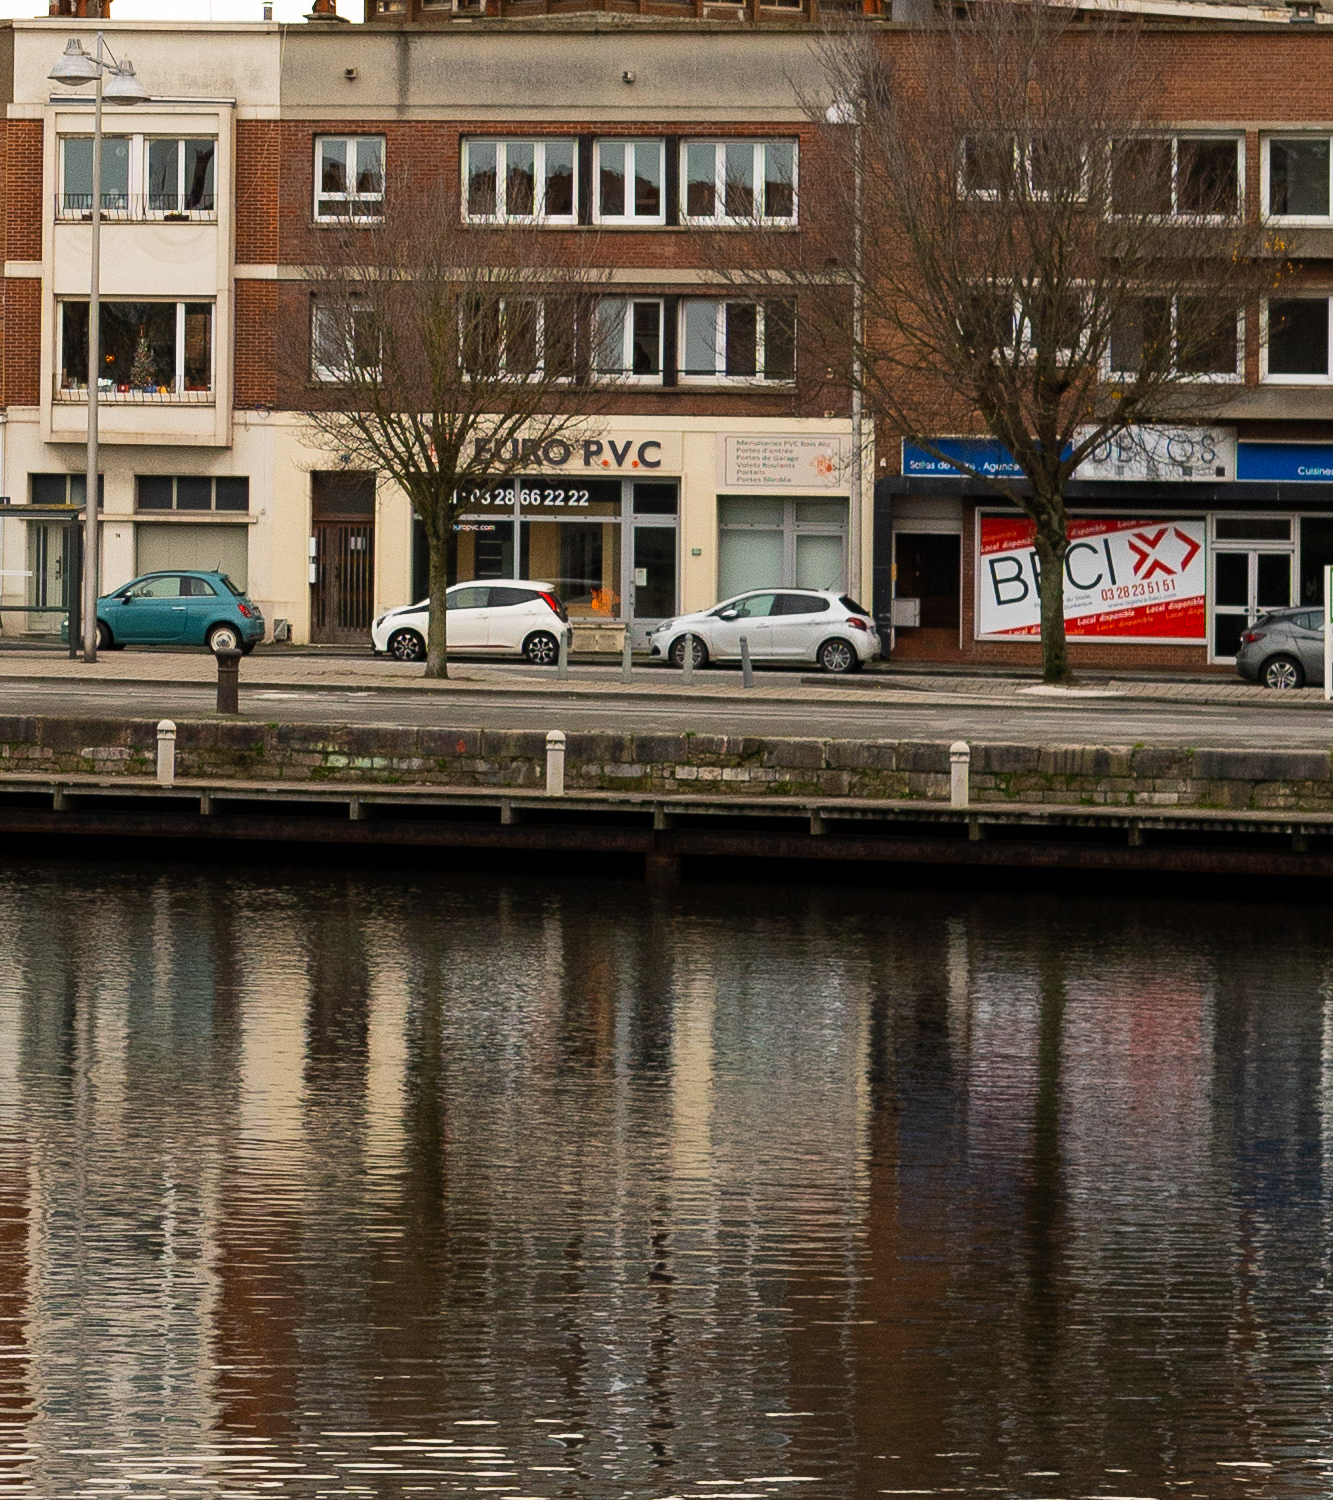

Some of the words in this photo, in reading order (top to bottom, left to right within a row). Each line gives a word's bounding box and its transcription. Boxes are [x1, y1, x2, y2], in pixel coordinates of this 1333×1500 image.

[474, 438, 572, 467] EURO
[773, 455, 799, 464] Garage
[937, 460, 951, 470] de
[494, 489, 515, 505] 28
[520, 489, 541, 506] 66
[544, 490, 565, 506] 22
[568, 490, 589, 506] 22
[1101, 588, 1115, 601] 03
[1117, 585, 1130, 599] 28
[1132, 583, 1146, 597] 23
[1148, 581, 1160, 594] 51
[1163, 578, 1176, 591] 51
[1077, 614, 1097, 626] Local
